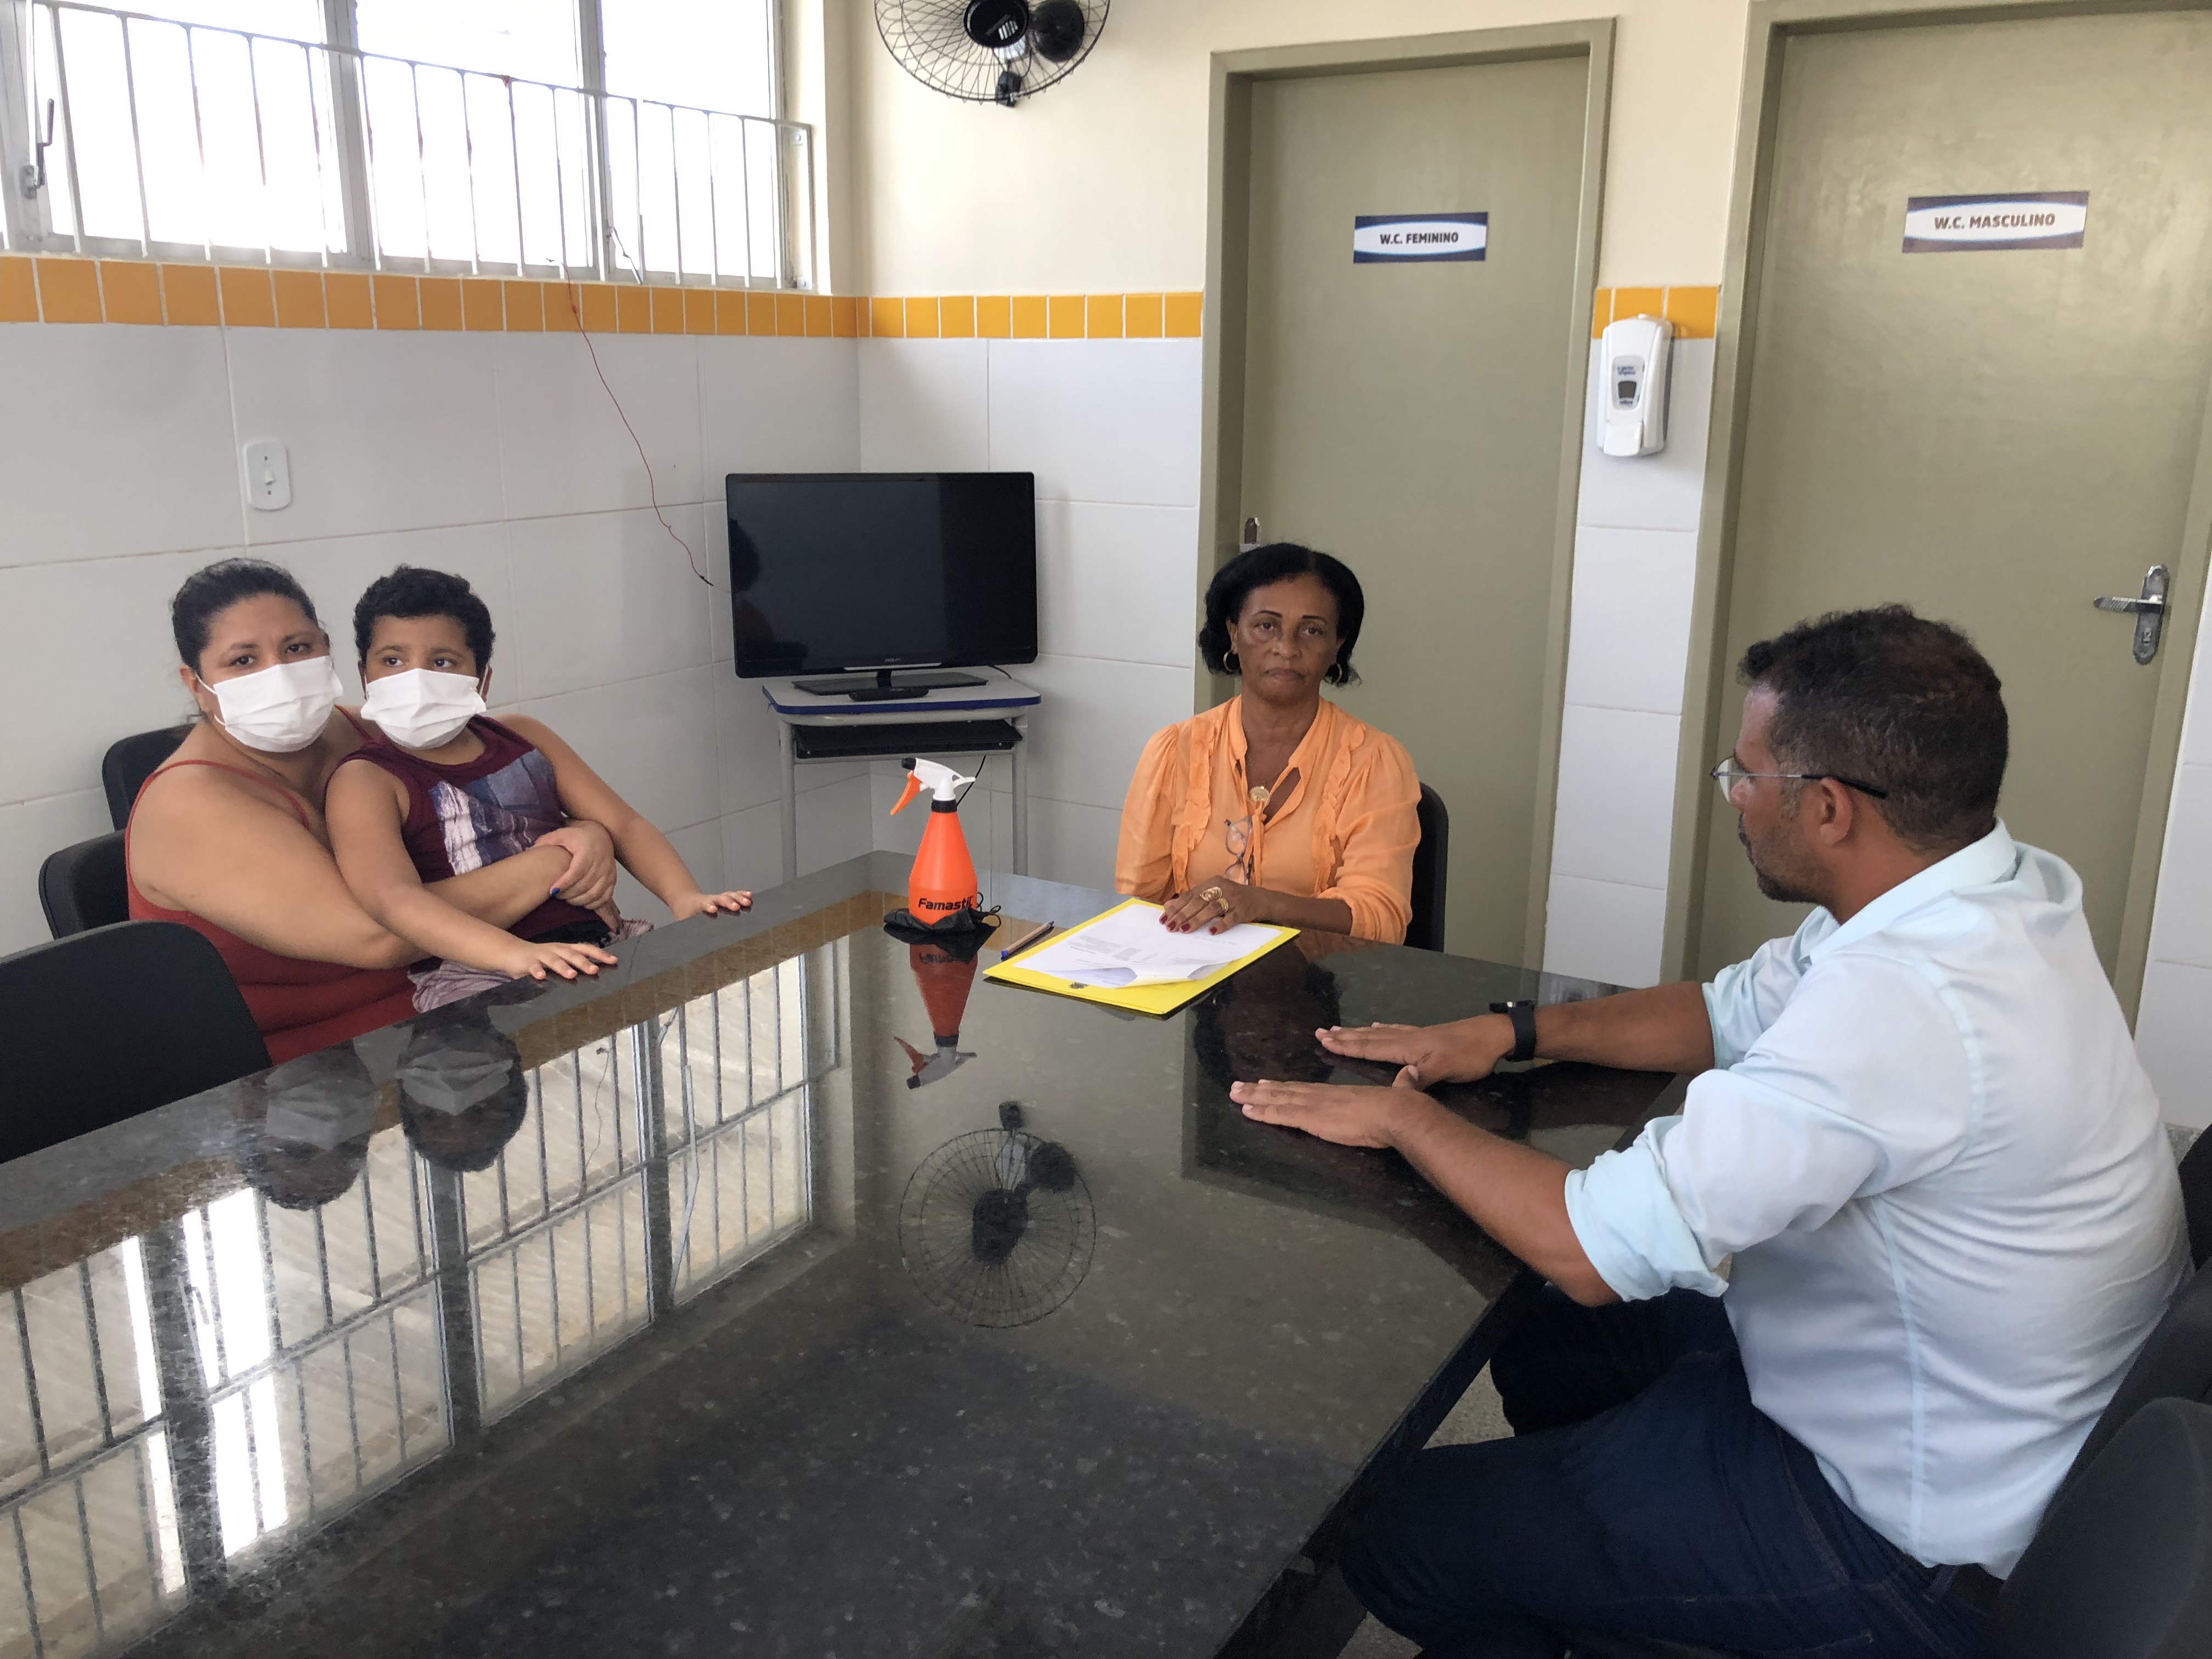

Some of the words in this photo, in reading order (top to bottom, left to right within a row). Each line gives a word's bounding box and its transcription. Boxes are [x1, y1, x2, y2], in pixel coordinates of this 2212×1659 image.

[1934, 217, 1965, 229] W.C.
[1969, 213, 2056, 228] MASCULINO
[1380, 234, 1403, 244] W.C.
[1406, 232, 1459, 244] FEMININO
[918, 896, 973, 911] Famastil
